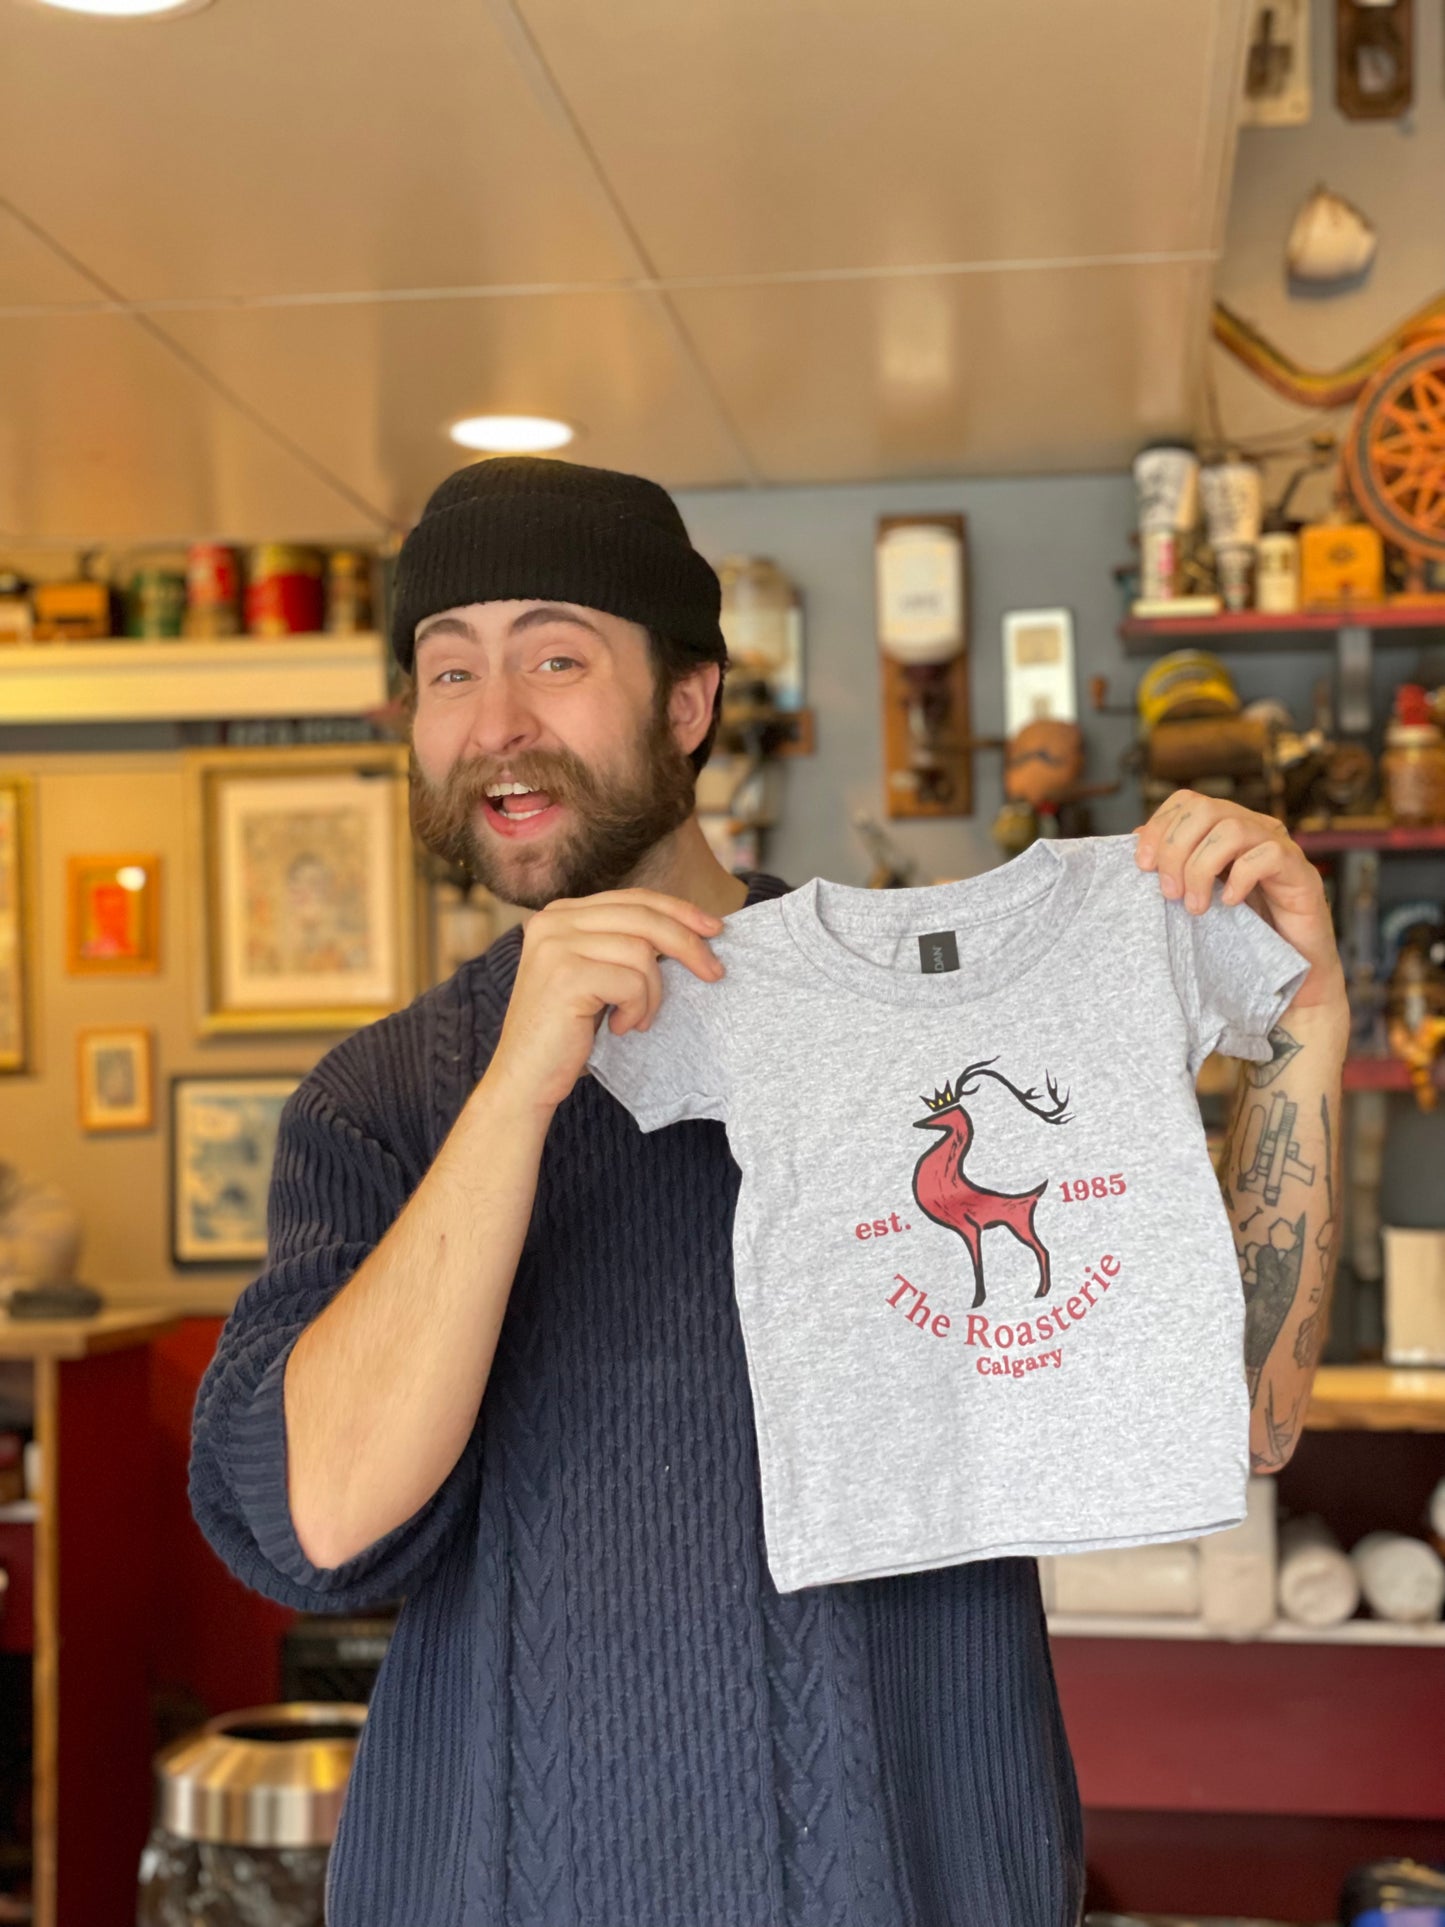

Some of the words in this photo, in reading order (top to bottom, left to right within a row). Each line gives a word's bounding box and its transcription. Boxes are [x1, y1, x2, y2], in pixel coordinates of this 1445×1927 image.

[1059, 1172, 1128, 1203] 1985
[854, 1211, 912, 1241] est.
[885, 1273, 952, 1338] The
[964, 1253, 1122, 1349] Roasterie
[975, 1347, 1064, 1379] Calgary
